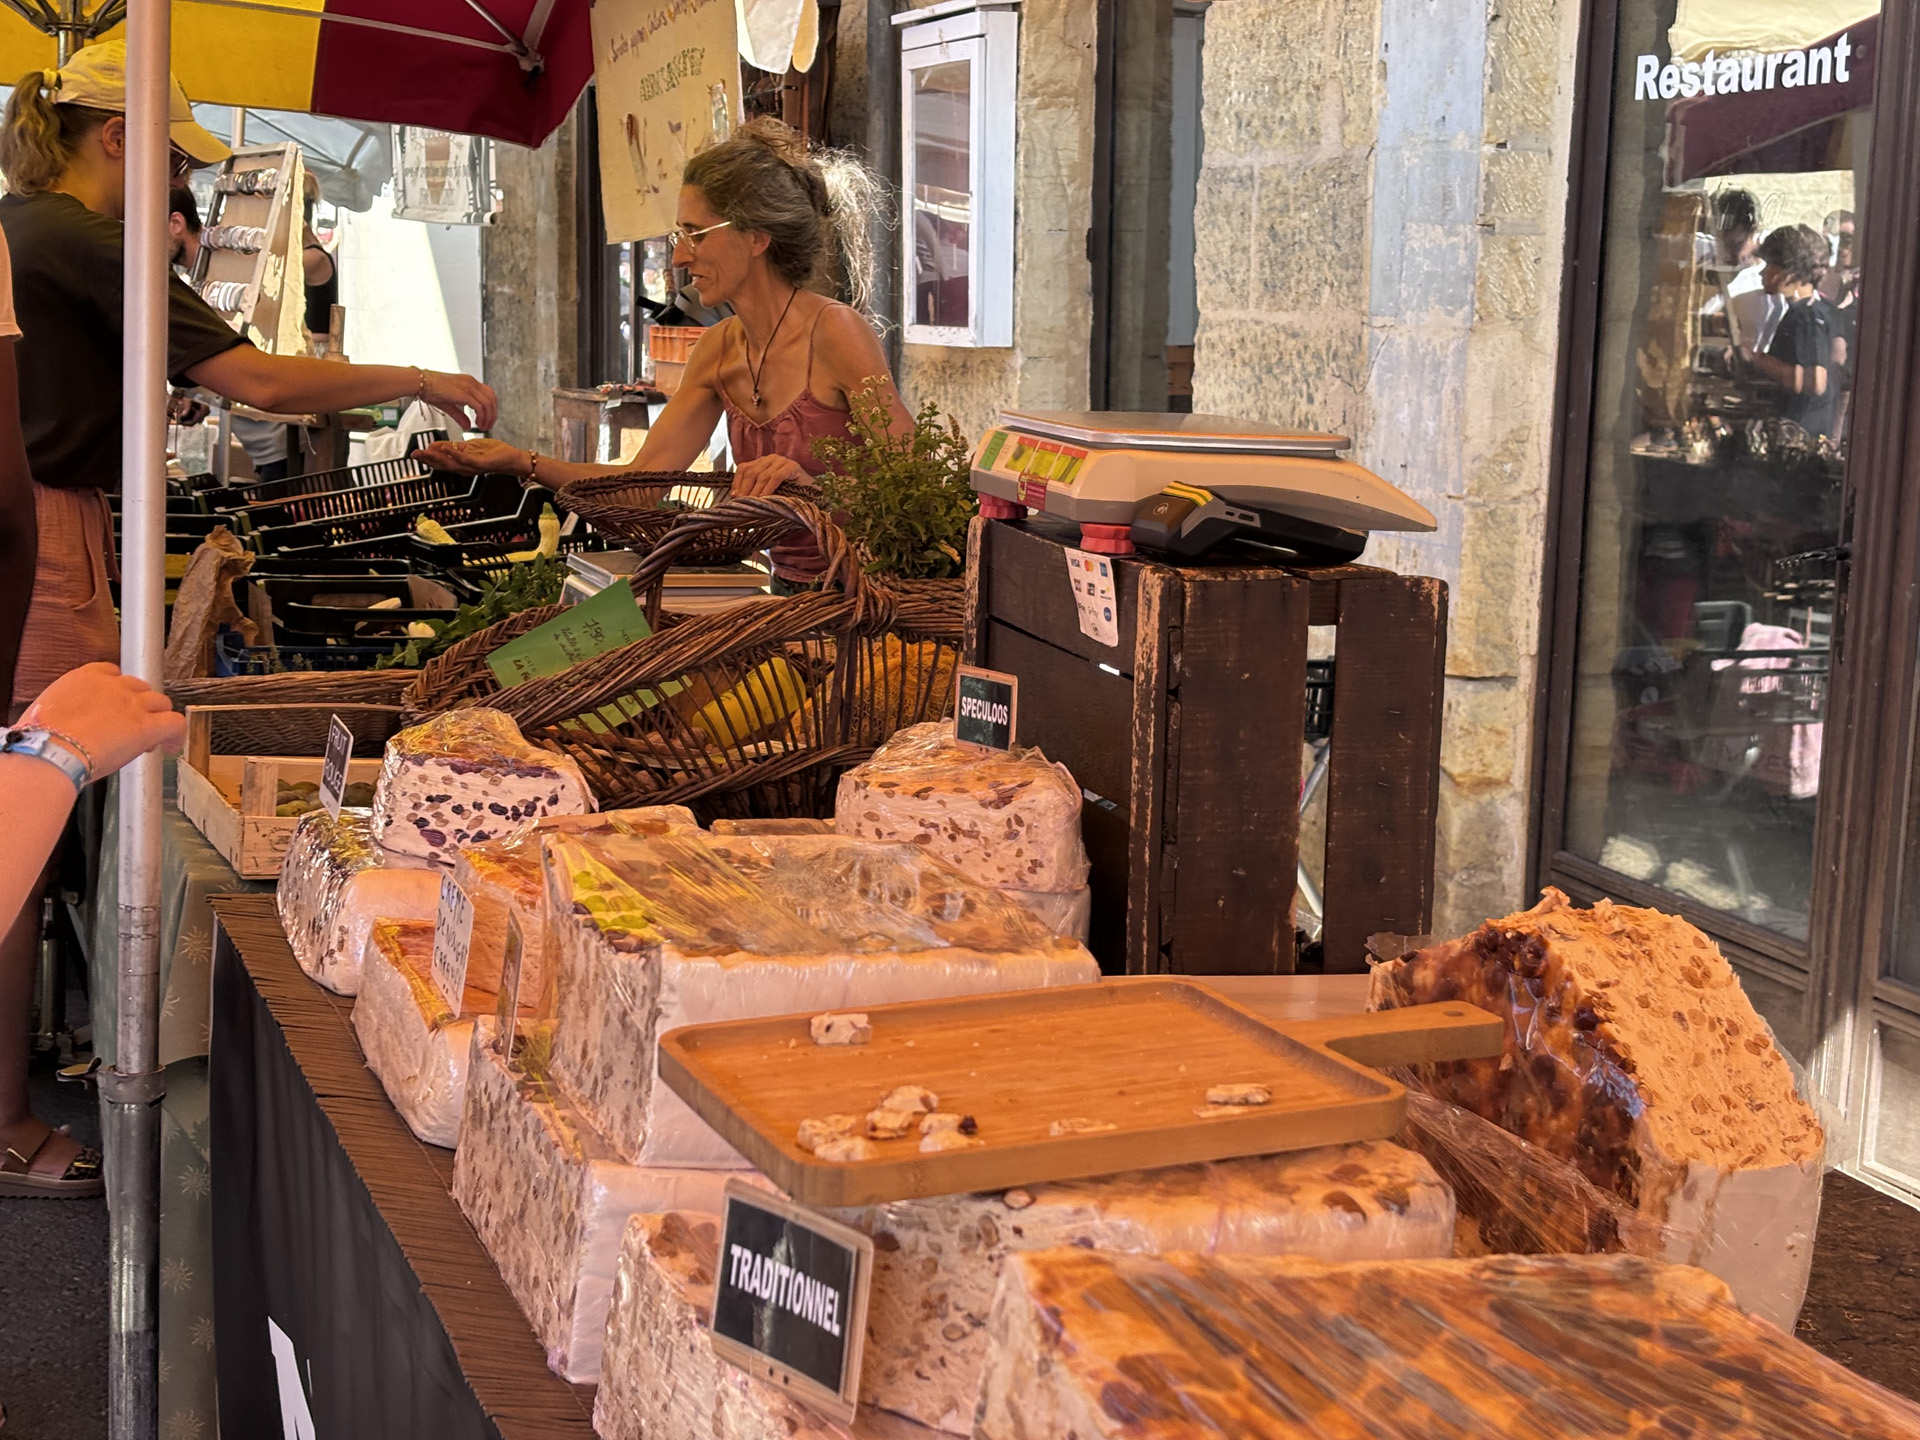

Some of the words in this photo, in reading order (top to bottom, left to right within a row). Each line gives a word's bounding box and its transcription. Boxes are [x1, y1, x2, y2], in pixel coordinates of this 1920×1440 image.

[1634, 32, 1851, 101] Restaurant
[961, 695, 1008, 726] SPECULOOS
[730, 1242, 840, 1337] TRADITIONNEL
